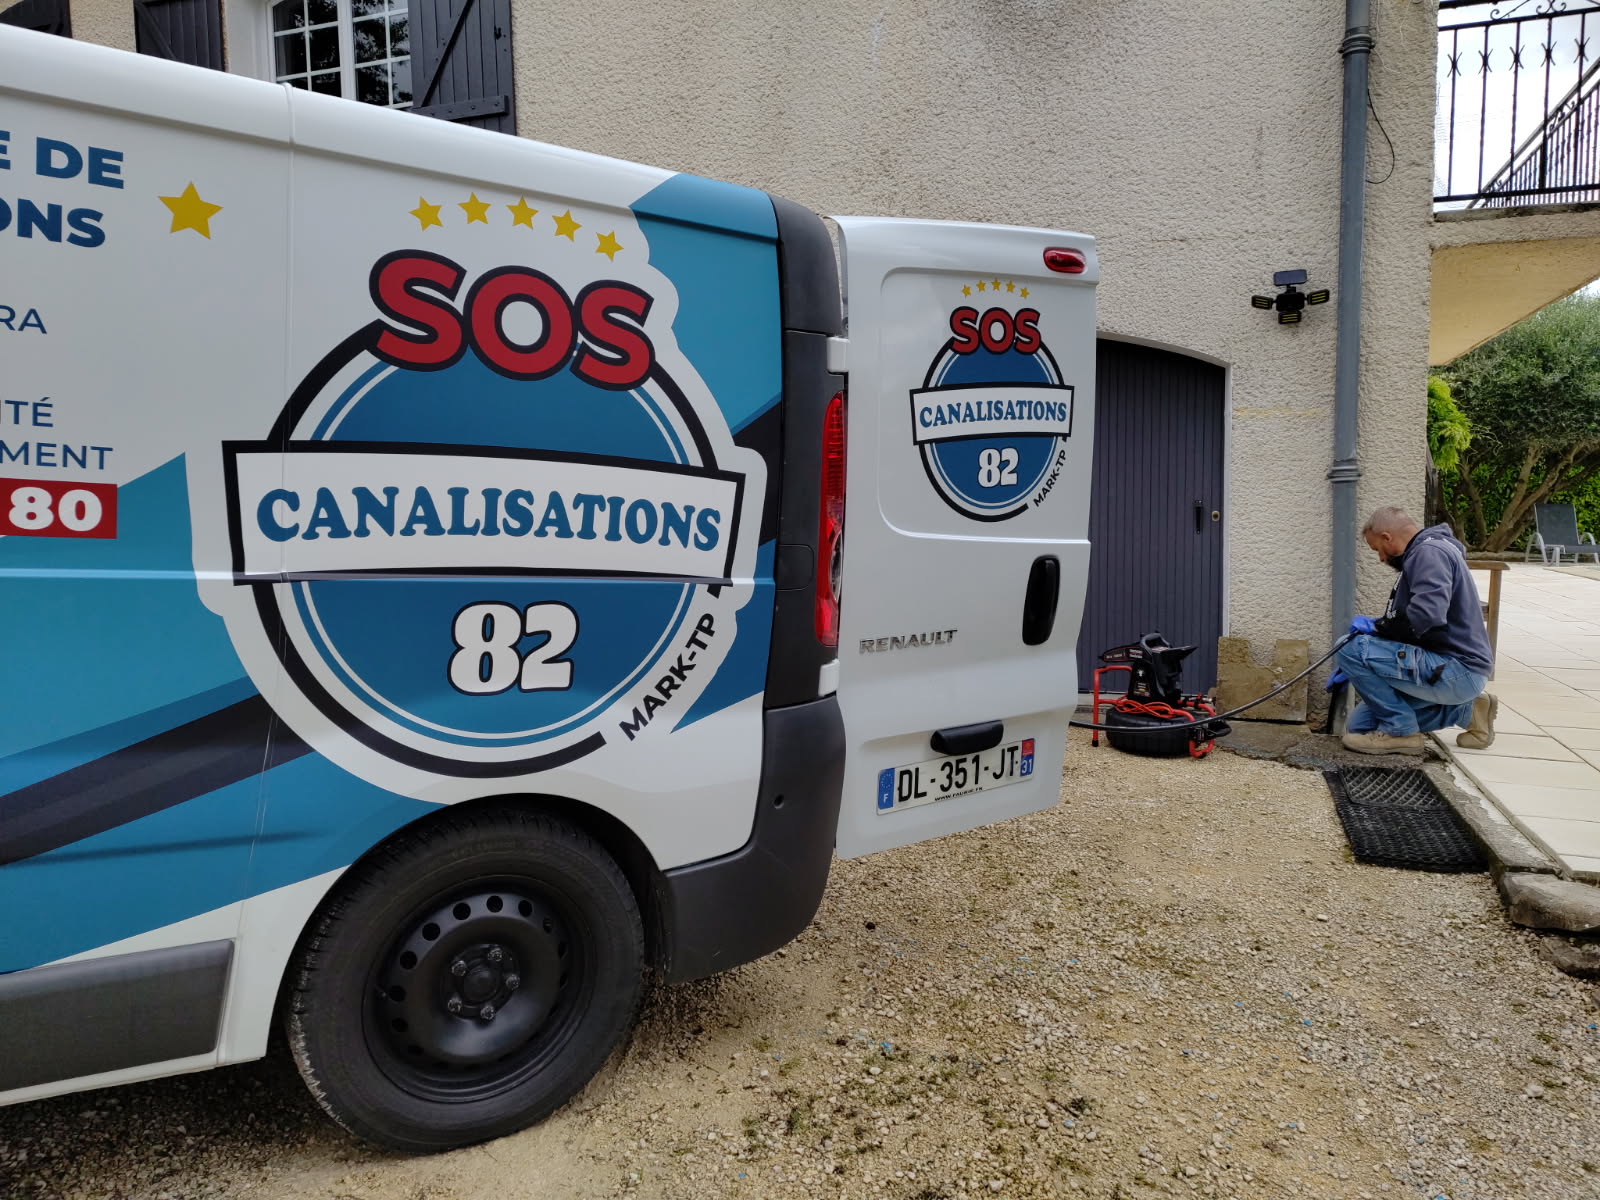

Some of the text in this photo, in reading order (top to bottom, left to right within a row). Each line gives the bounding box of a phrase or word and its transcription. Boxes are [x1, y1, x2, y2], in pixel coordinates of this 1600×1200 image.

[36, 136, 124, 189] DE
[0, 197, 106, 248] NS
[0, 304, 47, 334] RA
[369, 249, 655, 391] SOS
[949, 305, 1042, 356] SOS
[0, 396, 54, 428] TÉ
[919, 400, 1067, 429] CANALISATIONS
[0, 439, 113, 470] MENT
[977, 447, 1020, 488] 82
[1033, 449, 1067, 507] MARK-TP
[8, 486, 103, 532] 80
[256, 486, 721, 552] CANALISATIONS
[446, 600, 580, 697] 82
[859, 629, 958, 654] RENAULT
[618, 612, 716, 742] MARK-TP
[882, 745, 1033, 804] F DL-351-JT 31
